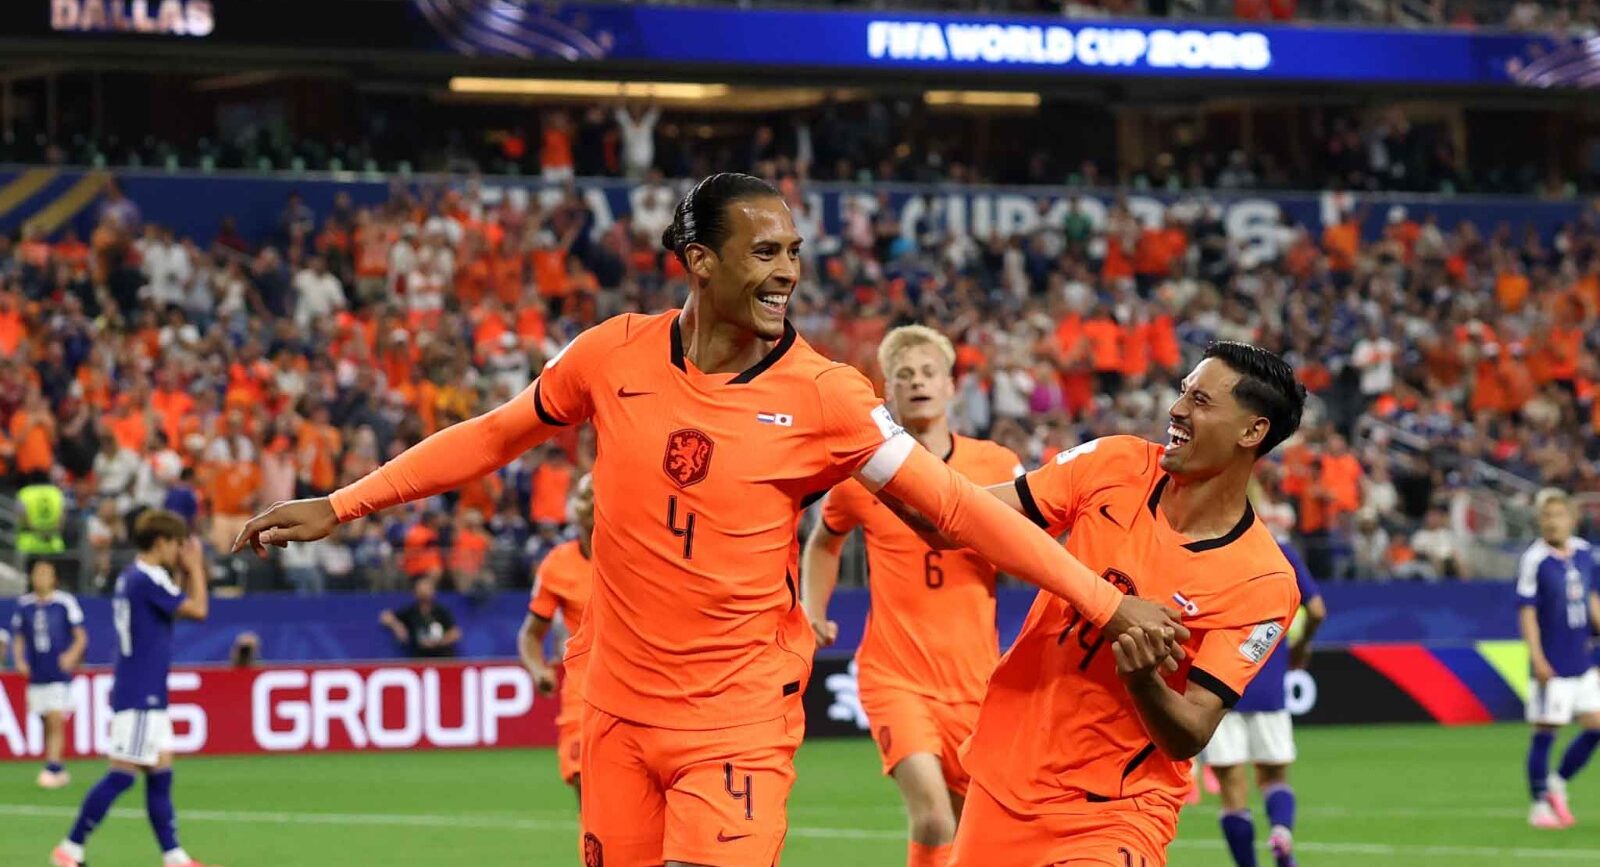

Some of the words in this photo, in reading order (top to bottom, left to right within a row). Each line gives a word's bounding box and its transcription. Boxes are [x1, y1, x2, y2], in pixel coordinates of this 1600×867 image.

[51, 0, 215, 36] DALLAS
[867, 20, 947, 60] FIFA
[946, 23, 1075, 64] WORLD
[1075, 26, 1147, 66] CUP
[1146, 30, 1271, 70] 2026
[667, 495, 695, 559] 4
[925, 550, 944, 589] 6
[252, 666, 534, 750] GROUP
[723, 762, 753, 820] 4
